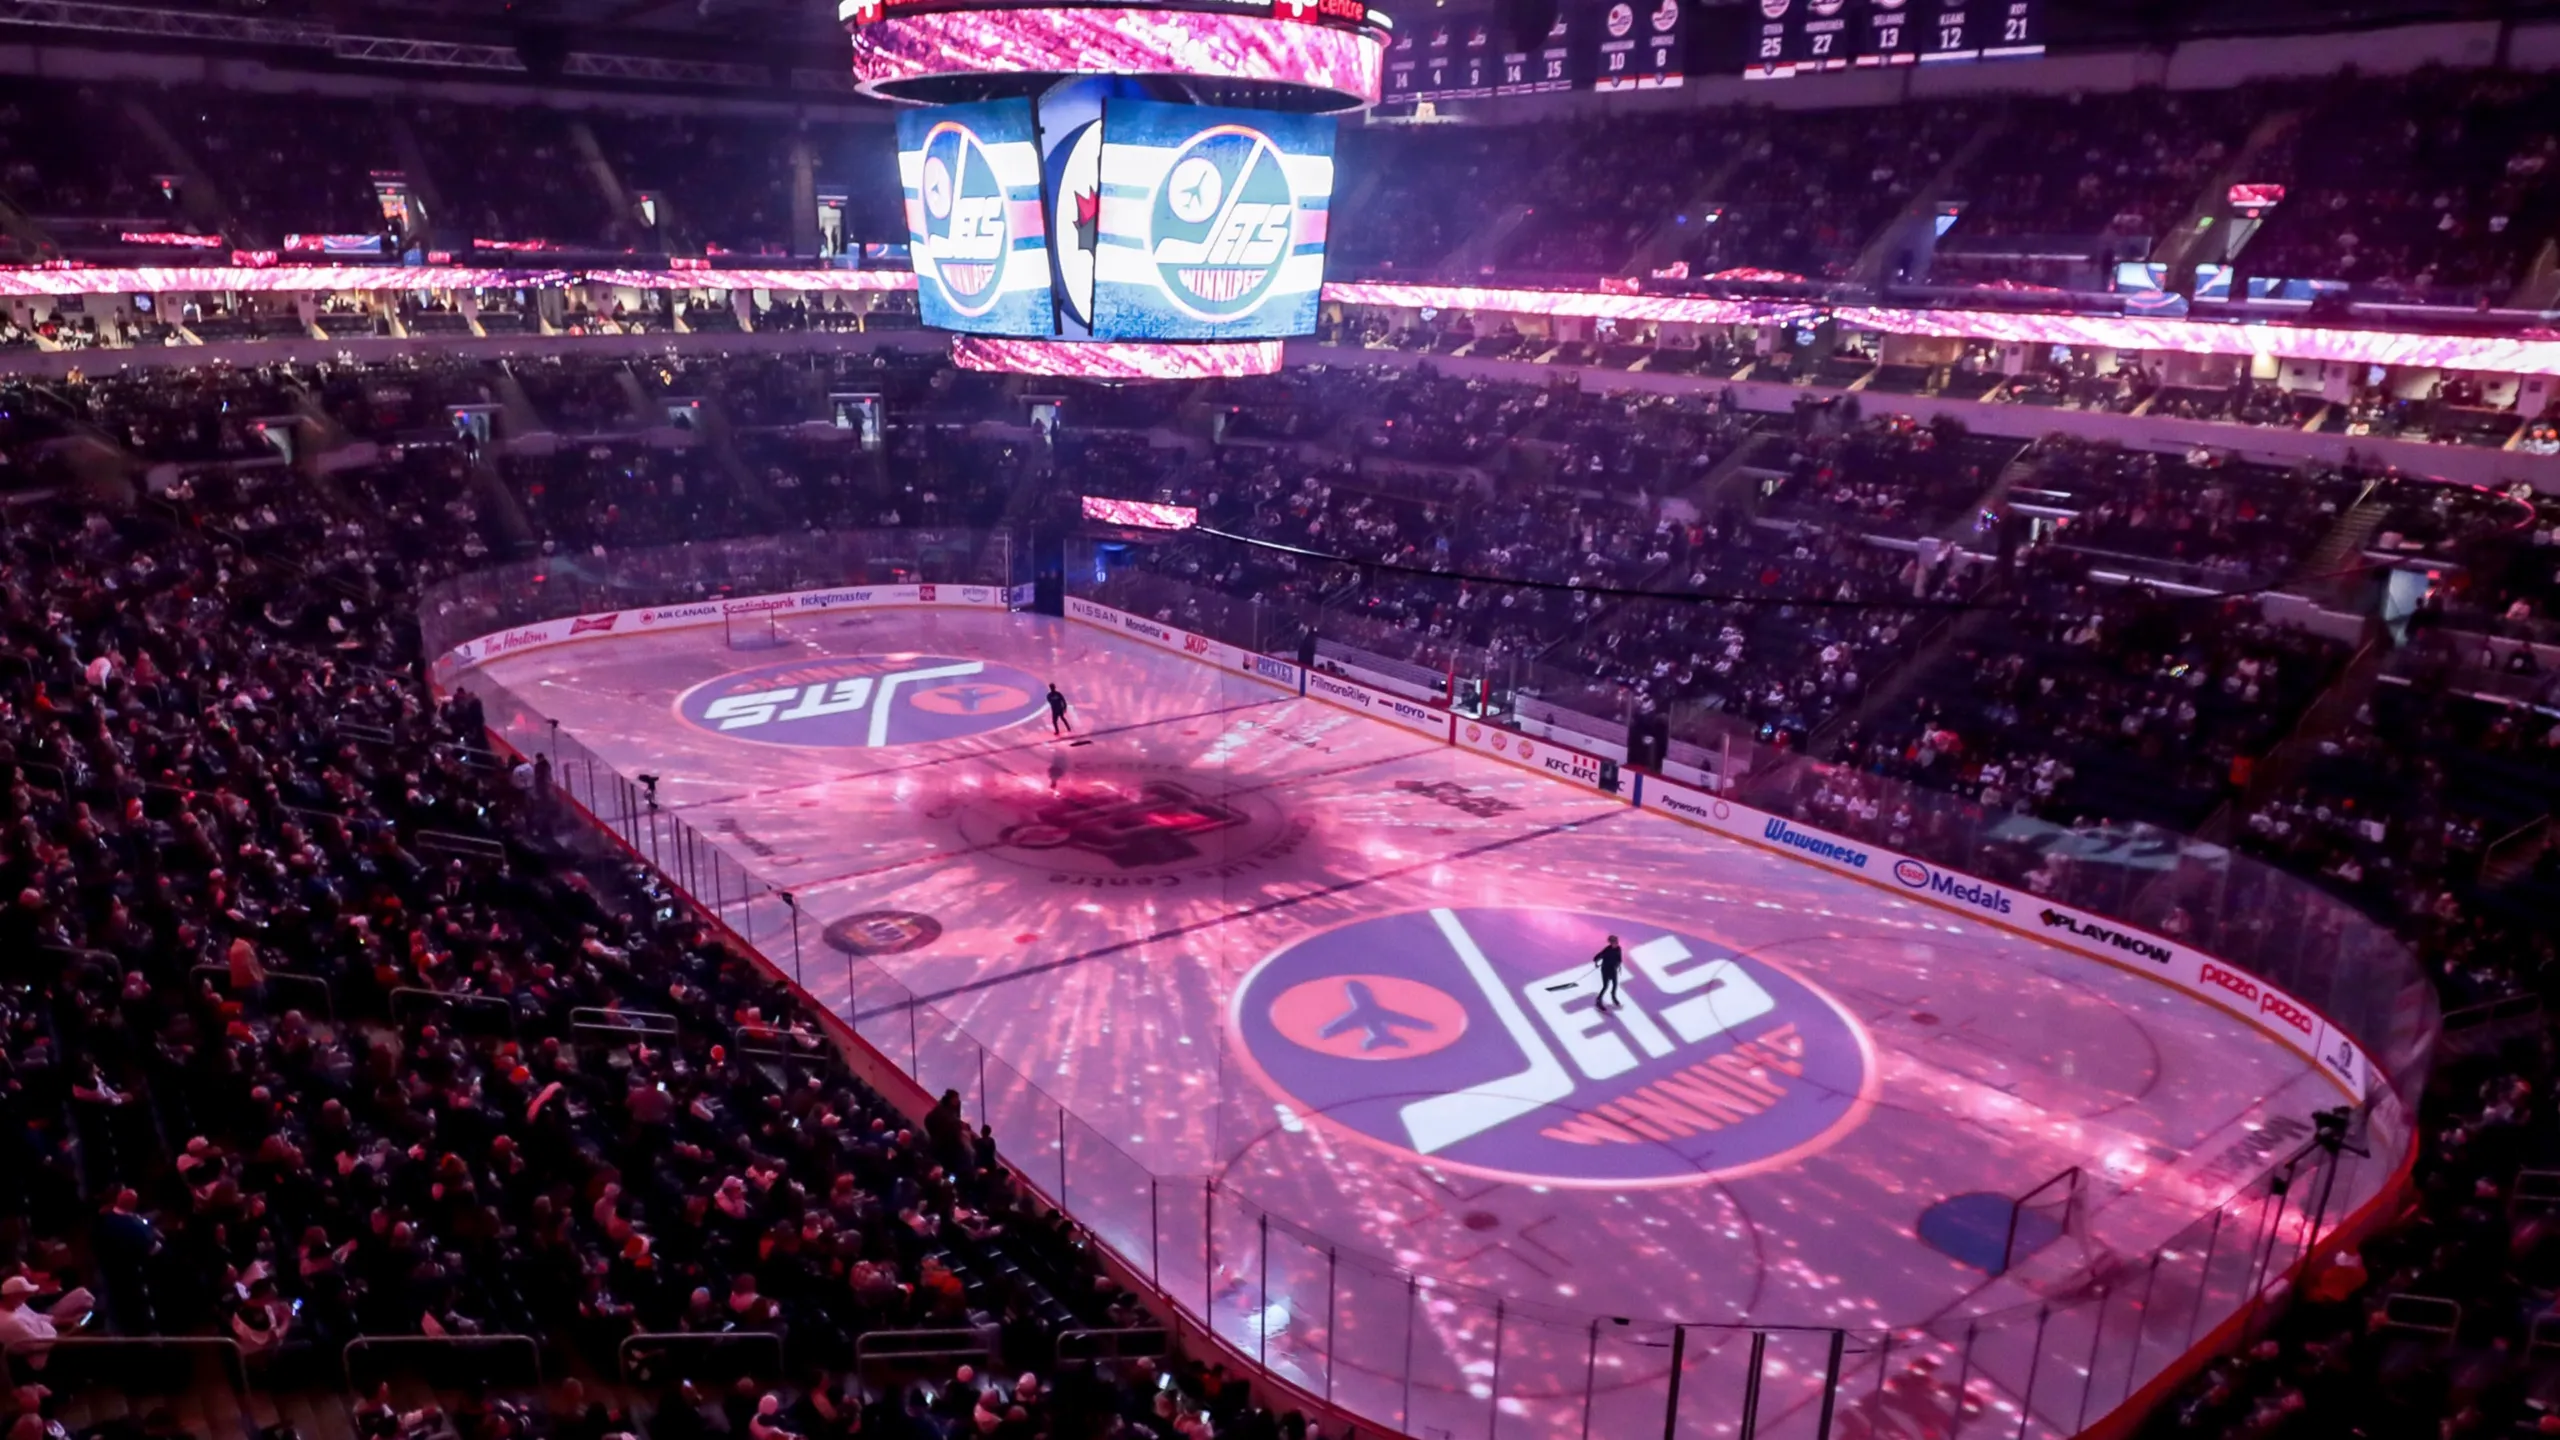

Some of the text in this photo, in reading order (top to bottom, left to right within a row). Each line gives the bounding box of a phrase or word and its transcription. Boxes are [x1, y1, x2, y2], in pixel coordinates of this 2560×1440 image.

[1880, 27, 1898, 48] 13
[1940, 27, 1962, 49] 12
[2004, 18, 2027, 41] 21
[1760, 37, 1781, 57] 25
[1812, 34, 1833, 55] 27
[1547, 60, 1561, 78] 15
[1609, 52, 1625, 71] 10
[1396, 72, 1408, 88] 14
[1433, 70, 1441, 86] 4
[1471, 69, 1479, 86] 9
[1507, 66, 1521, 83] 14
[1154, 137, 1292, 265] JETS
[801, 590, 873, 608] ticketmaster
[656, 605, 717, 621] AIR CANADA
[1072, 601, 1118, 624] NISSAN
[504, 630, 548, 650] Hortons
[1184, 634, 1208, 655] SKIP
[1310, 674, 1371, 707] FillmoreRiley
[703, 661, 984, 747] JETS
[1395, 702, 1425, 719] BOYD
[1545, 756, 1597, 782] KFC KFC
[1662, 794, 1707, 817] Payworks
[1764, 817, 1868, 868] Wawanesa
[1931, 871, 2011, 914] Medals
[2052, 911, 2173, 965] PLAYNOW
[2200, 963, 2313, 1036] pizza pizza
[1399, 908, 1775, 1155] JETS
[1539, 1022, 1804, 1146] WINNIPEG
